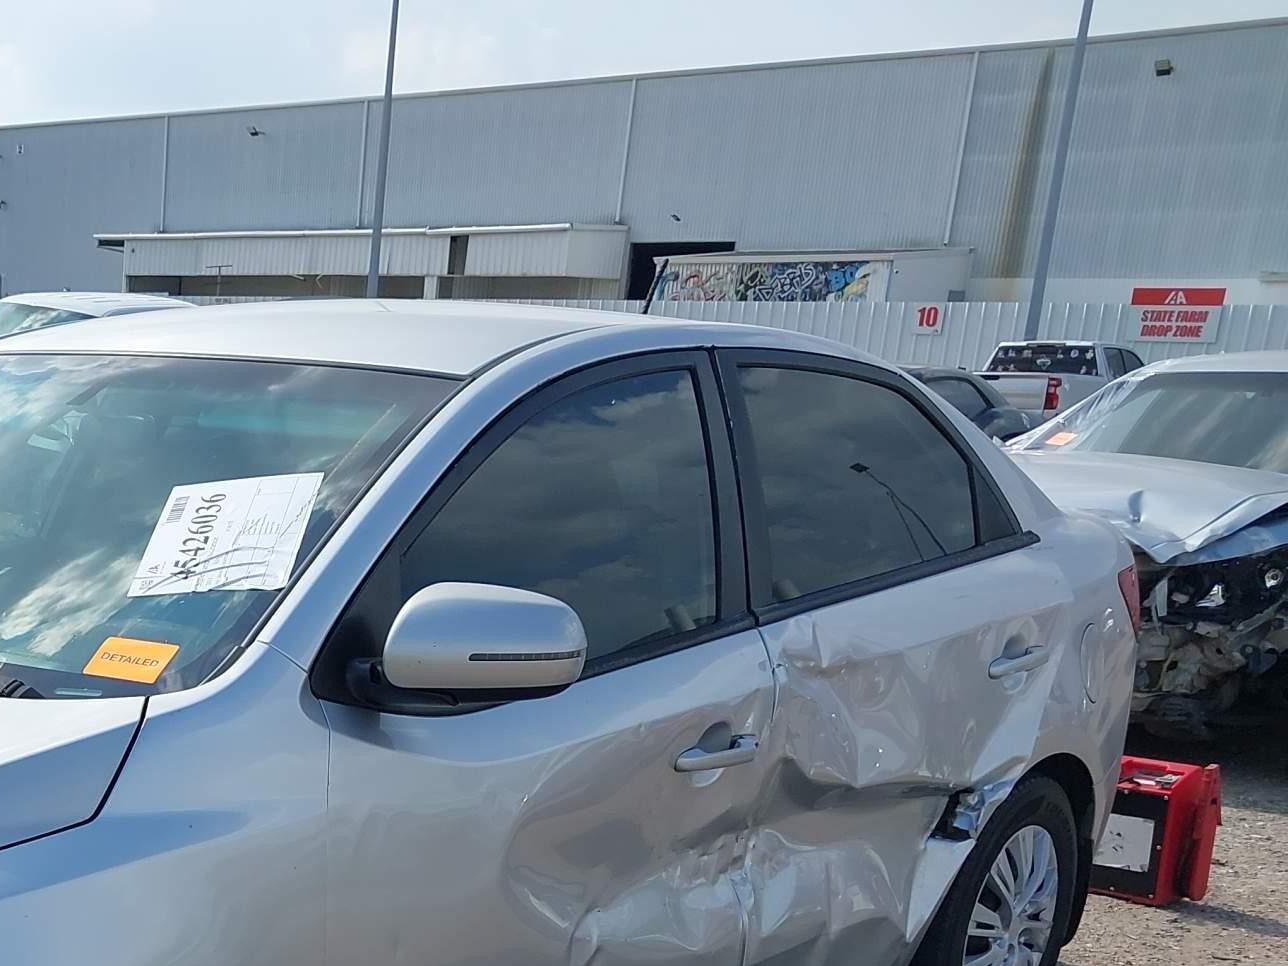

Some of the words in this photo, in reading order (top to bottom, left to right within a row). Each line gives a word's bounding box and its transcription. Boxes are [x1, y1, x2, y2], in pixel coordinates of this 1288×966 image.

[917, 306, 939, 327] 10
[1141, 310, 1175, 323] STATE
[1175, 310, 1209, 323] FARM
[1140, 324, 1173, 337] DROP
[1173, 325, 1203, 338] ZONE
[170, 493, 227, 580] 45426036
[100, 651, 160, 667] DETAILED
